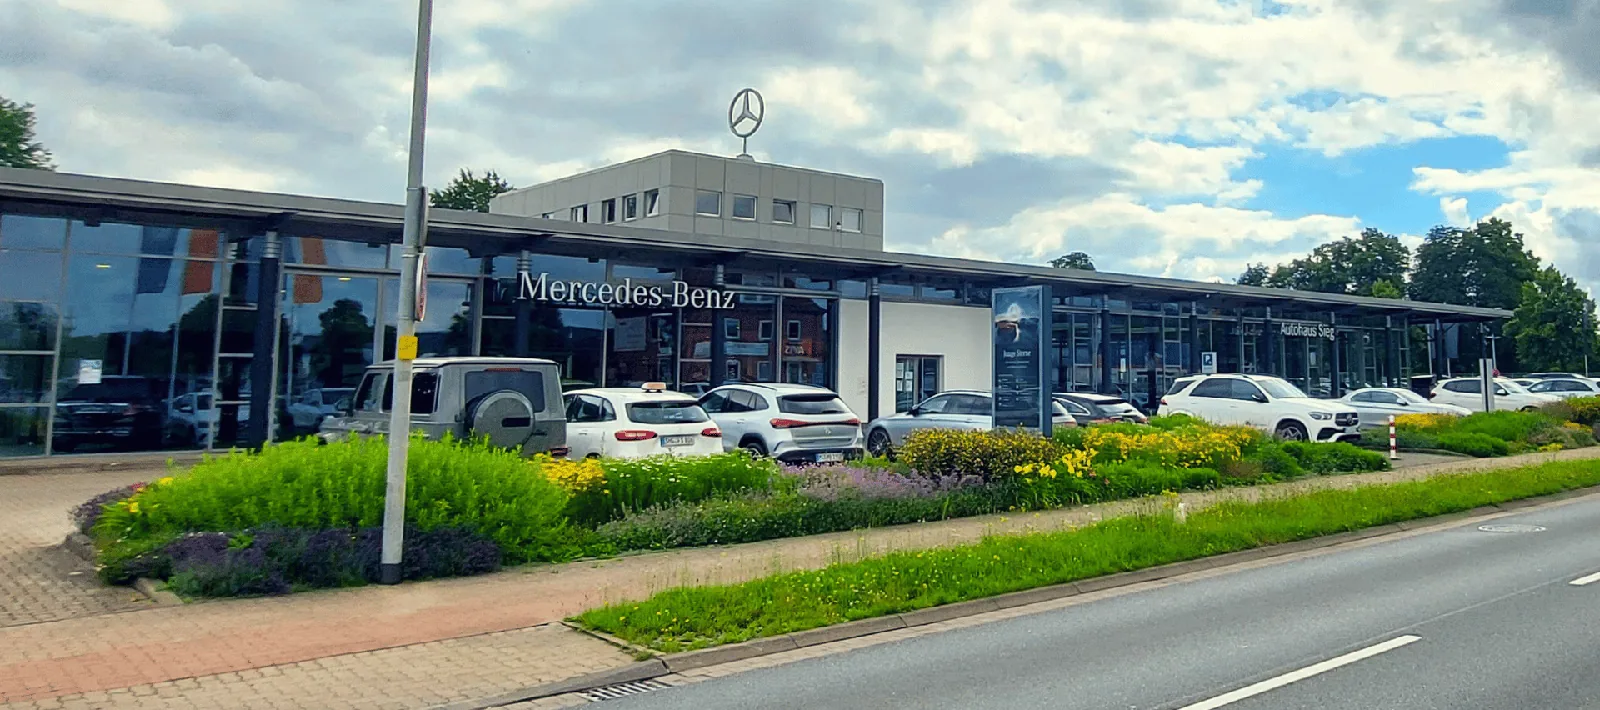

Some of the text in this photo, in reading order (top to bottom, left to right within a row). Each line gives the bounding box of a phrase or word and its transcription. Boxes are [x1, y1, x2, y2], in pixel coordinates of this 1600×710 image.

[516, 271, 735, 309] Mercedes-Benz
[1280, 322, 1335, 341] Autohaus Sieg
